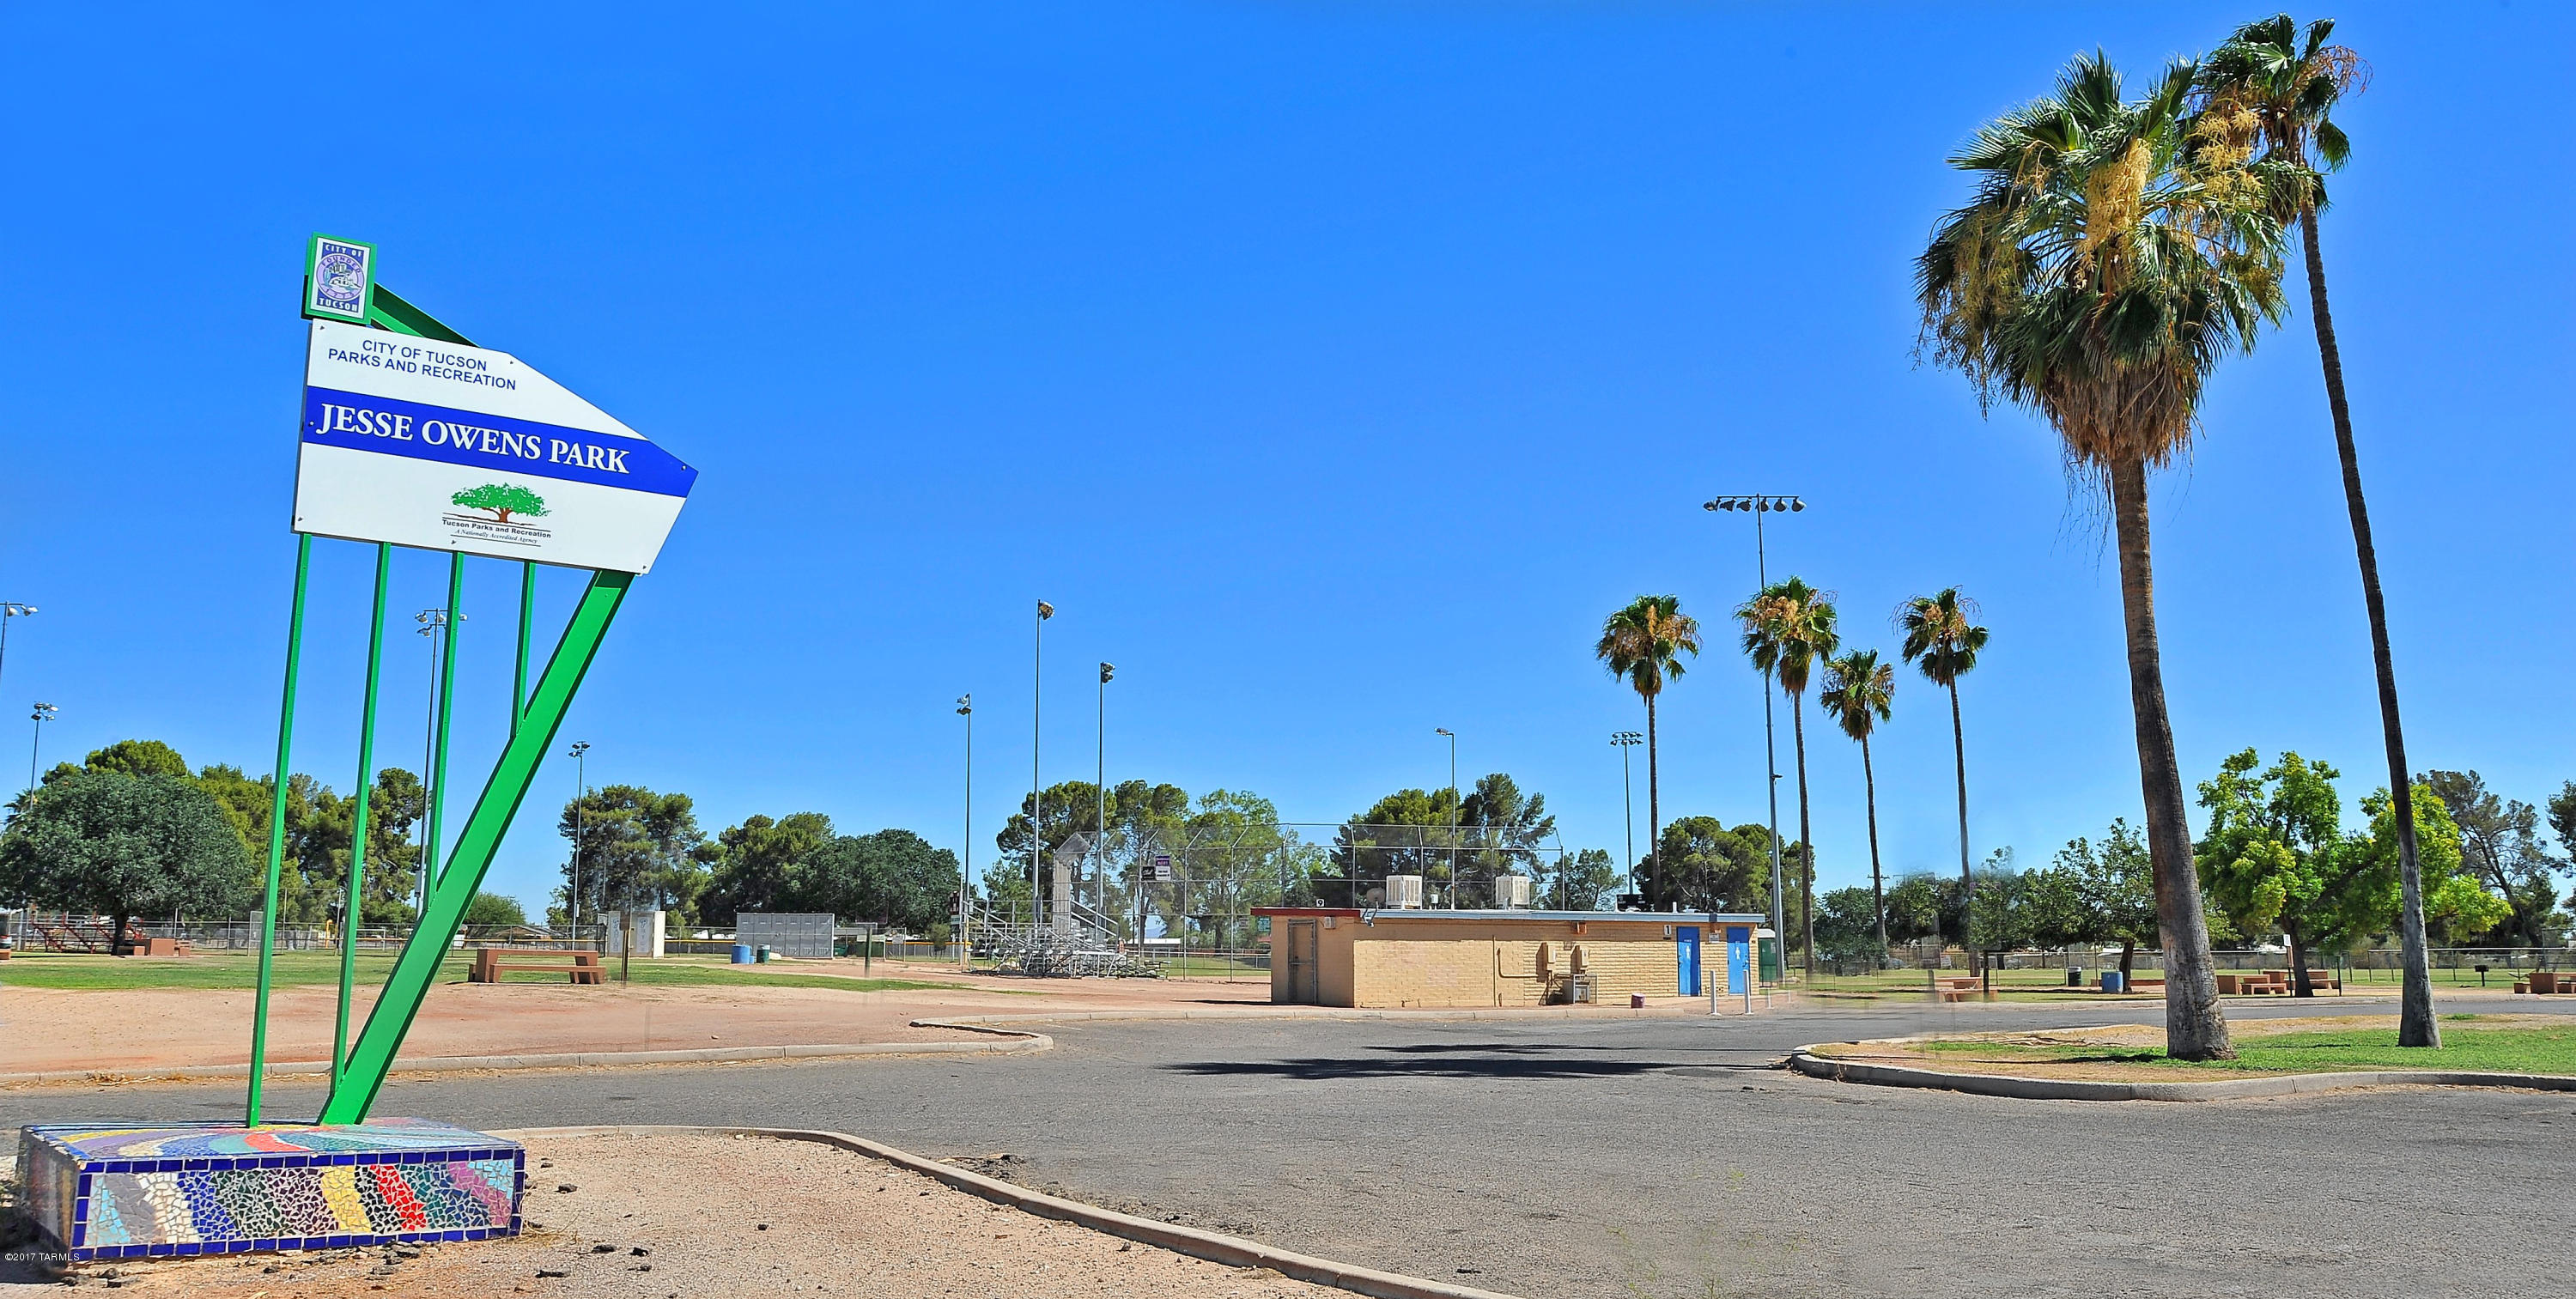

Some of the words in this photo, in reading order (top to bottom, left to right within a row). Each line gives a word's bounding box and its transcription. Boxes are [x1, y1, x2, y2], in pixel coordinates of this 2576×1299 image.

[325, 245, 347, 254] CITY
[352, 249, 363, 258] OF
[322, 257, 361, 273] FOUNDED
[319, 297, 358, 312] TUCSON
[362, 340, 397, 355] CITY
[401, 346, 421, 360] OF
[426, 350, 487, 371] TUCSON
[328, 349, 380, 367] PARKS
[385, 358, 417, 373] AND
[422, 364, 516, 391] RECREATION
[315, 403, 414, 441] JESSE
[422, 420, 542, 460] OWENS
[548, 439, 630, 474] PARK
[442, 519, 470, 529] Tucson
[471, 523, 493, 531] Parks
[511, 528, 551, 538] Recreation
[461, 529, 489, 538] Nationally
[489, 533, 518, 542] Accredited
